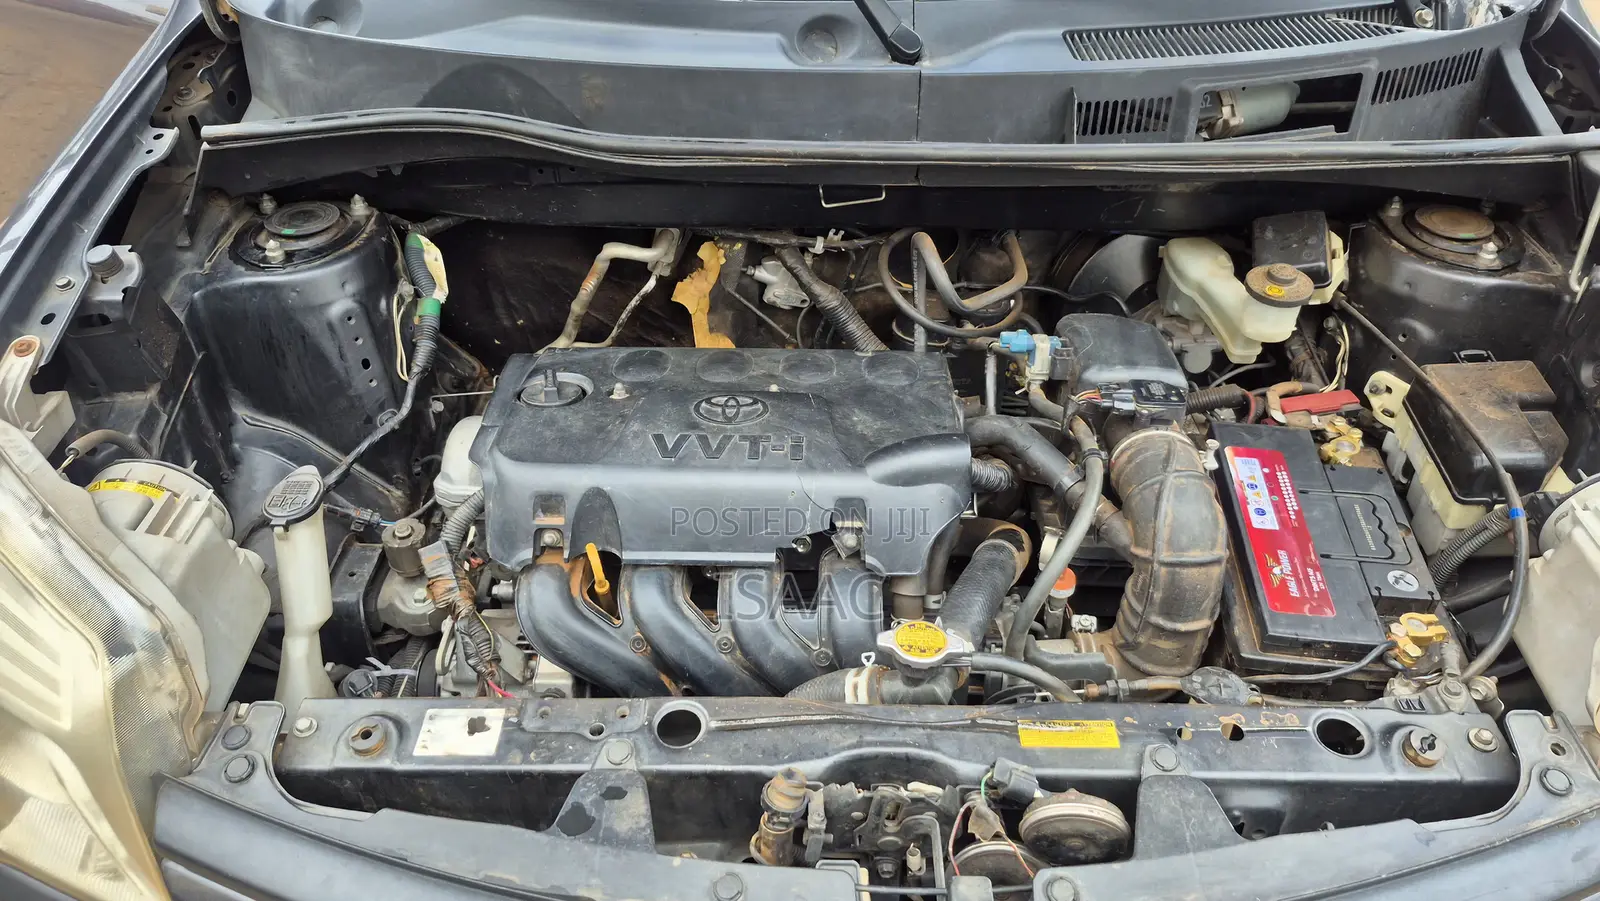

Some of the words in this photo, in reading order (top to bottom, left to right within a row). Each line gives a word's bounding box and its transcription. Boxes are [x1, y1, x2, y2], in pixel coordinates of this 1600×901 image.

[650, 432, 805, 461] VVT-i
[1277, 549, 1293, 575] POWER
[1284, 574, 1300, 598] EAGLE
